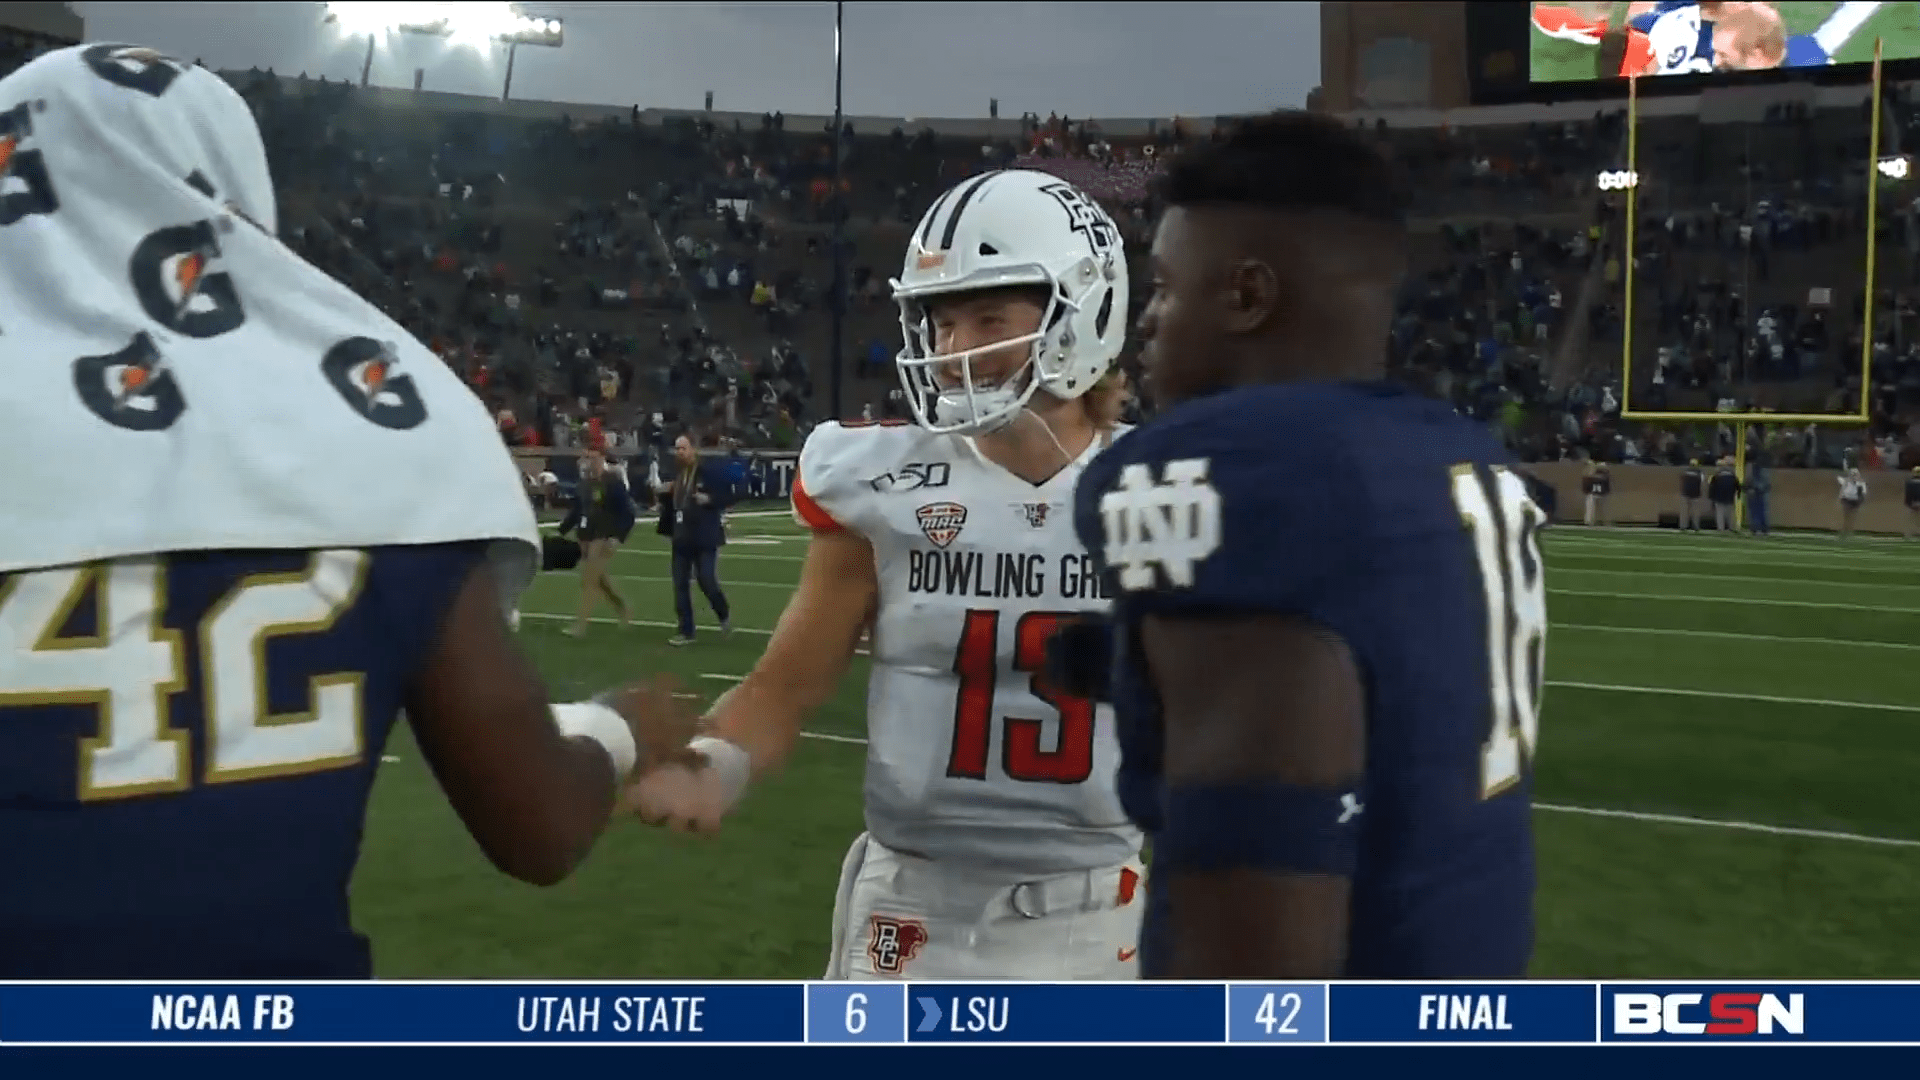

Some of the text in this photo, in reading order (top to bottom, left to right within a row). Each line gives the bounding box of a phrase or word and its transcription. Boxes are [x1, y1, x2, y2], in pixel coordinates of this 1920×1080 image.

[0, 548, 371, 800] 42
[908, 549, 1046, 598] BOWLING
[1448, 461, 1547, 801] 18
[946, 607, 1097, 784] 13
